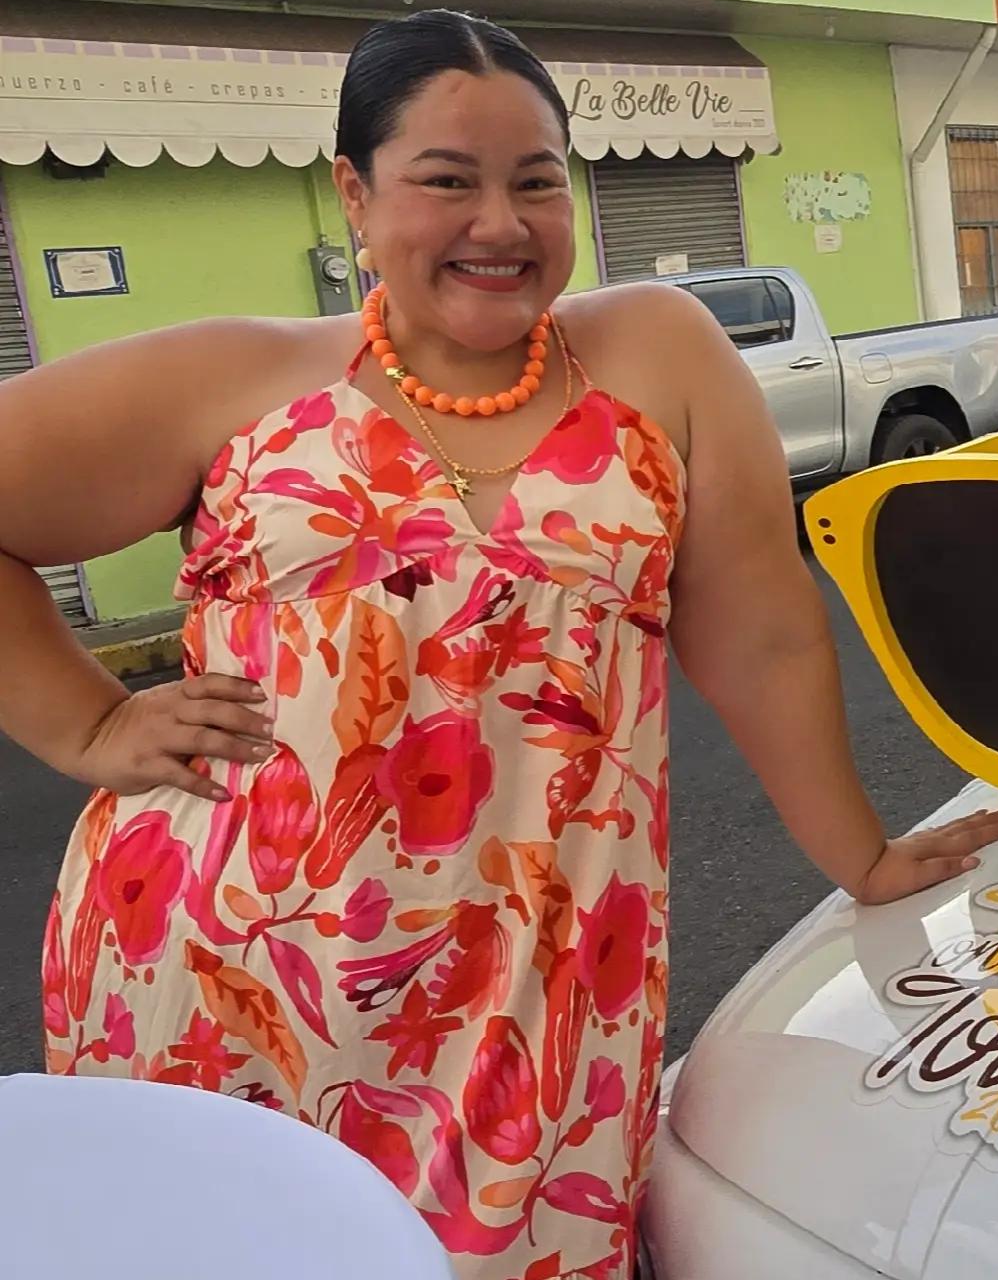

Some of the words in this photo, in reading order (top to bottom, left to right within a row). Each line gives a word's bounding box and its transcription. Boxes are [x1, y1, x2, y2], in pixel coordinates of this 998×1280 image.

[124, 76, 173, 94] café
[211, 82, 285, 99] crepas
[567, 78, 605, 121] La
[611, 80, 681, 121] Belle
[685, 81, 733, 120] Vie
